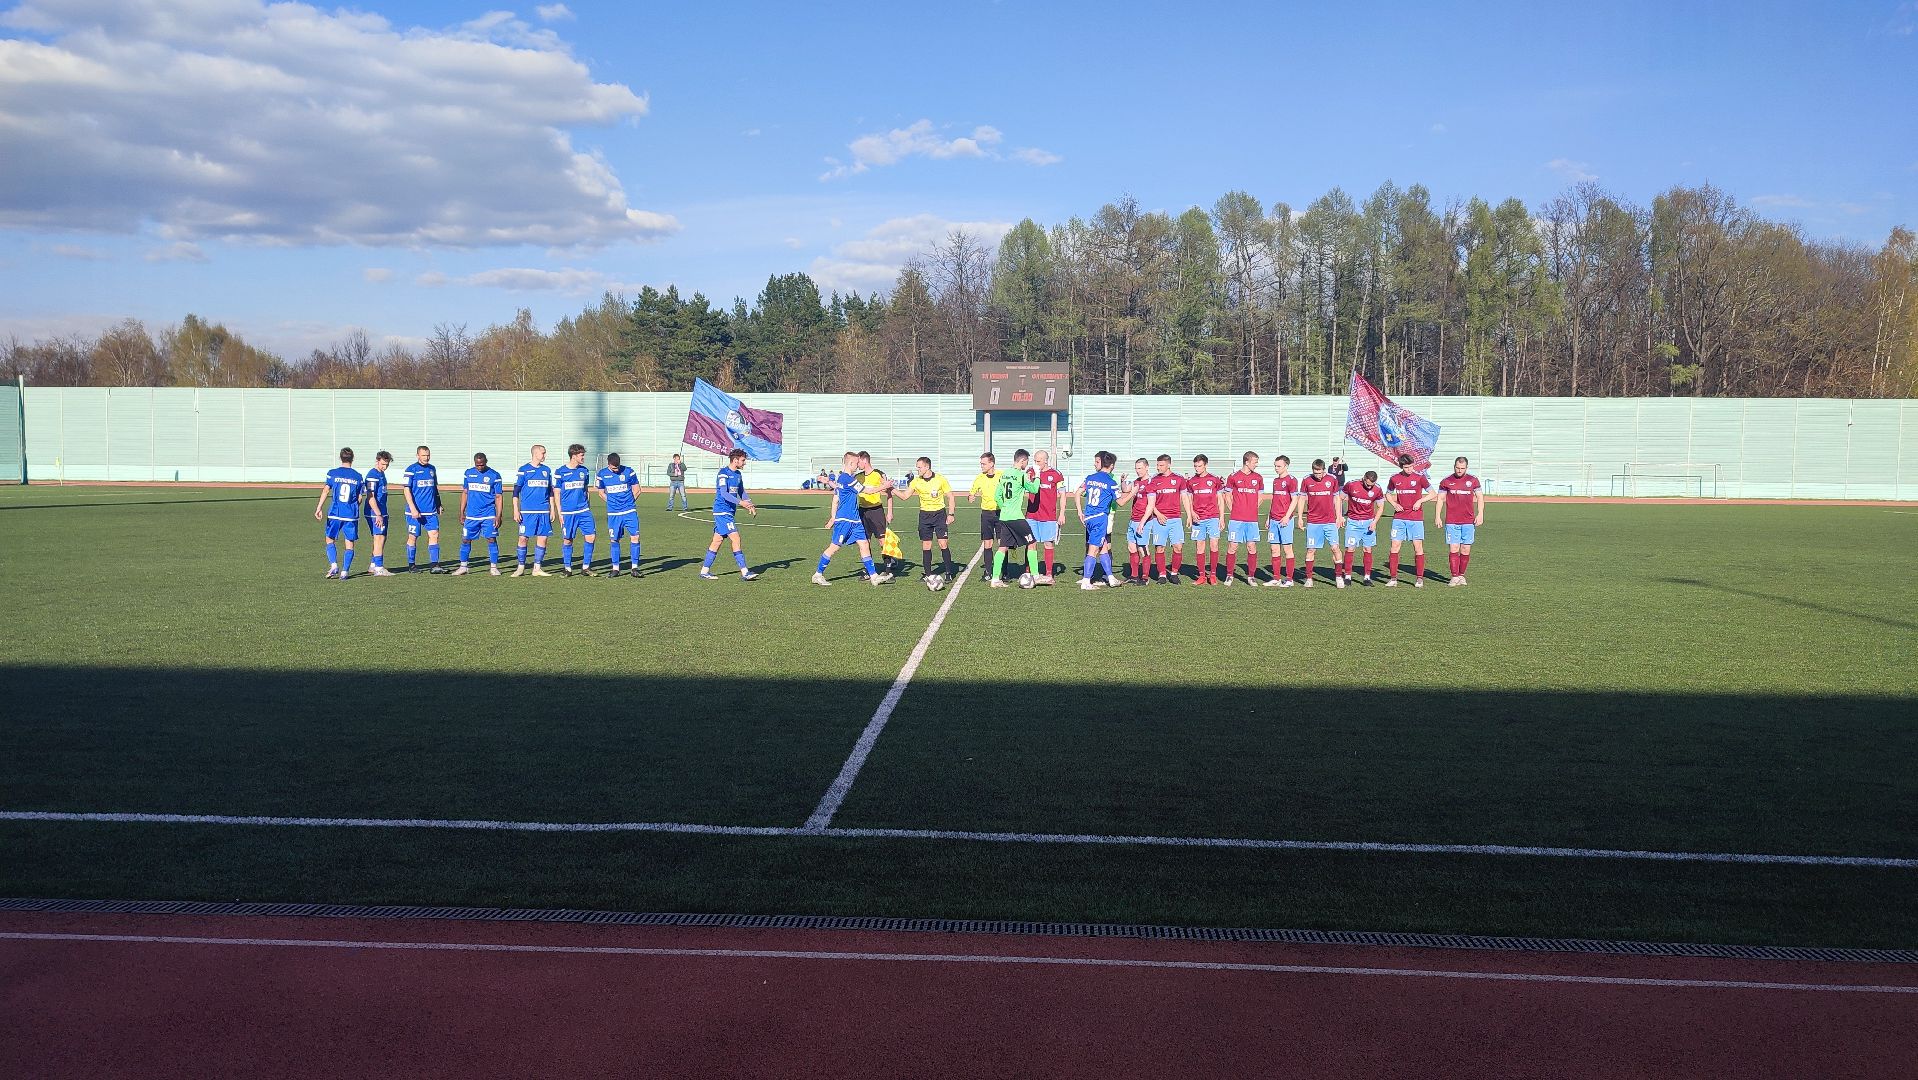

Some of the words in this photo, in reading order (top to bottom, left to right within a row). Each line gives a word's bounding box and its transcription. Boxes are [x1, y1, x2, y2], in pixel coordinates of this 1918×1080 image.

[989, 387, 1001, 405] 0
[1044, 387, 1056, 406] 0
[338, 483, 351, 503] 9
[1087, 486, 1100, 507] 13
